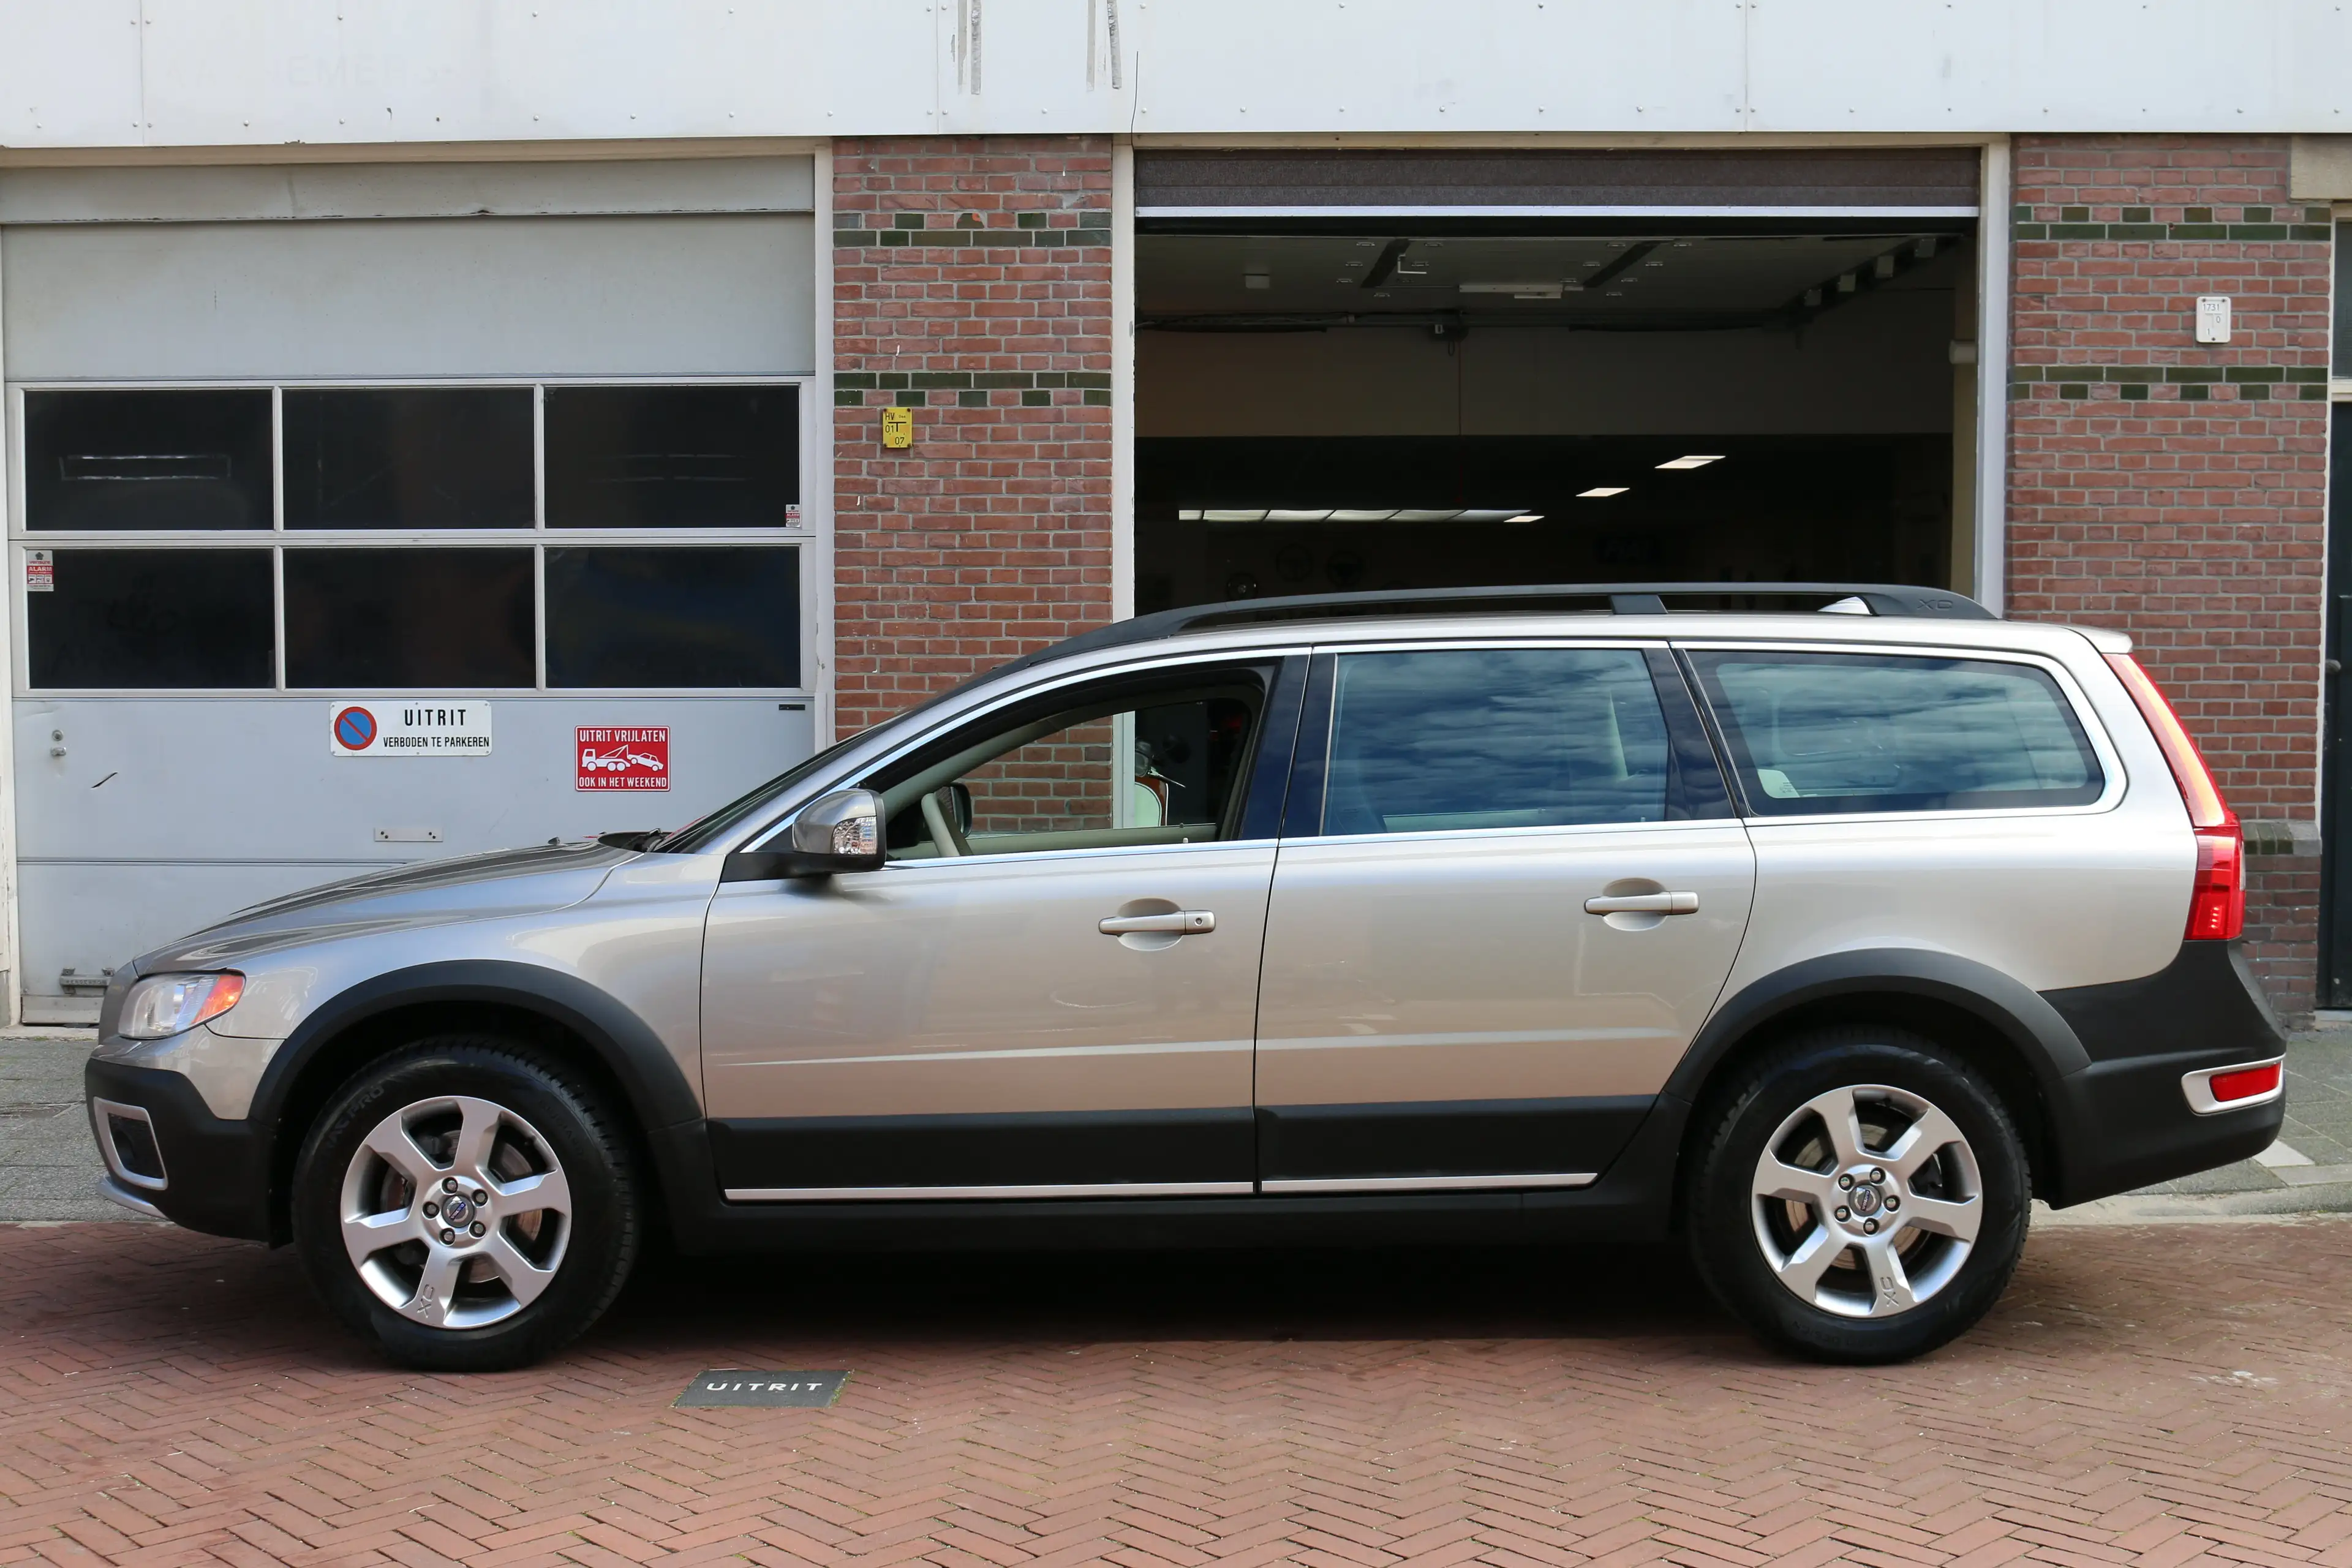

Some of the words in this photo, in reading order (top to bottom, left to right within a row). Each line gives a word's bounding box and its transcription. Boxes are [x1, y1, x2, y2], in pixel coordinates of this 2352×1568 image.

[2215, 315, 2221, 324] 0
[1917, 599, 1953, 611] XC
[404, 709, 466, 726] UITRIT
[383, 737, 428, 747] VERBODEN
[431, 737, 442, 747] TE
[445, 737, 489, 747] PARKEREN
[579, 730, 612, 742] UITRIT
[614, 730, 666, 742] VRIJLATEN
[579, 777, 595, 787] OOK
[598, 777, 606, 787] IN
[609, 777, 625, 787] HET
[627, 777, 667, 787] WEEKEND
[1880, 1276, 1899, 1306] XC
[417, 1284, 434, 1318] XC
[706, 1382, 823, 1391] UITRIT
